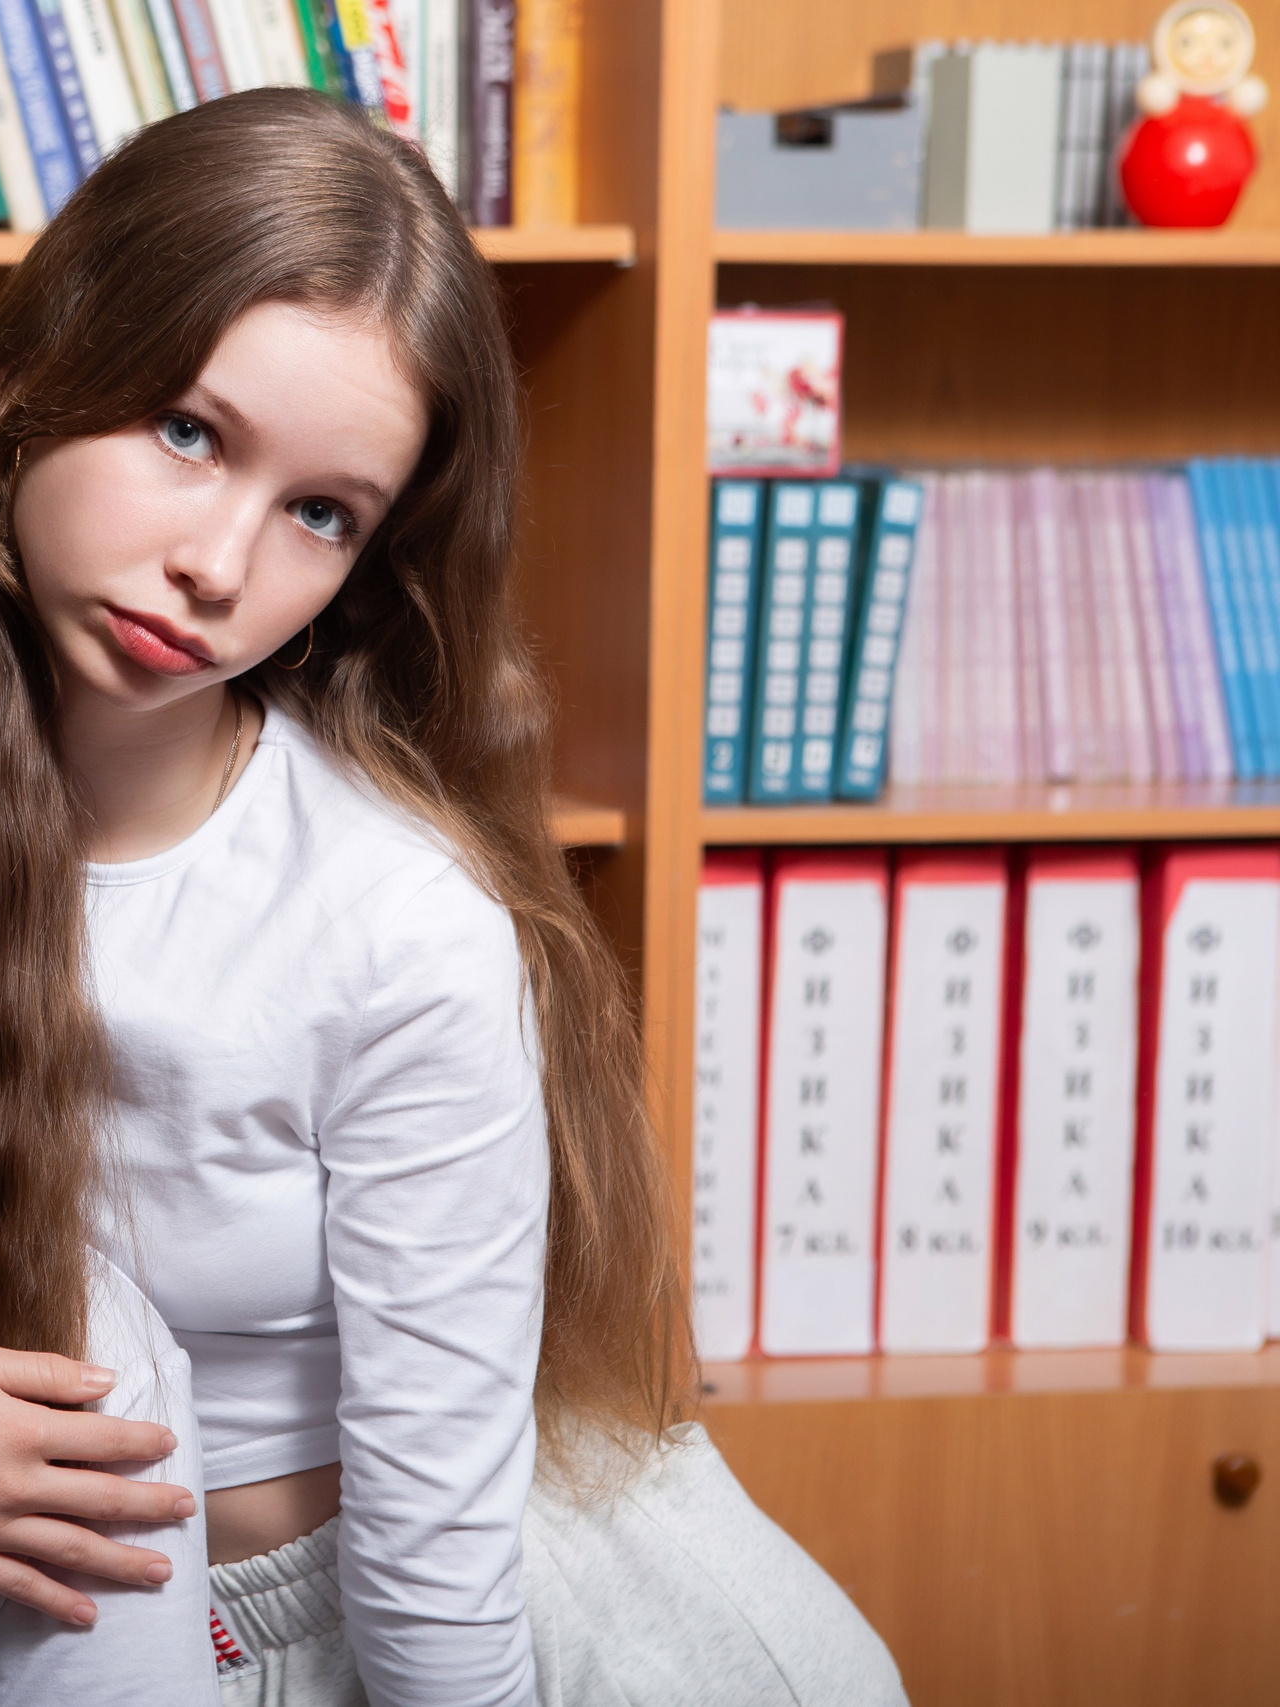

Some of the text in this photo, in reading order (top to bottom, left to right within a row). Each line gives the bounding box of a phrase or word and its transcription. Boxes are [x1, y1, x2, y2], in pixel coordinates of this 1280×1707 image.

[795, 926, 834, 1206] ФИЗИКА
[932, 926, 978, 1206] ФИЗИКА
[1061, 922, 1102, 1199] ФИЗИКА
[1181, 924, 1222, 1204] ФИЗИКА
[775, 1222, 797, 1256] 7
[1026, 1215, 1049, 1249] 9
[1163, 1217, 1200, 1253] 10
